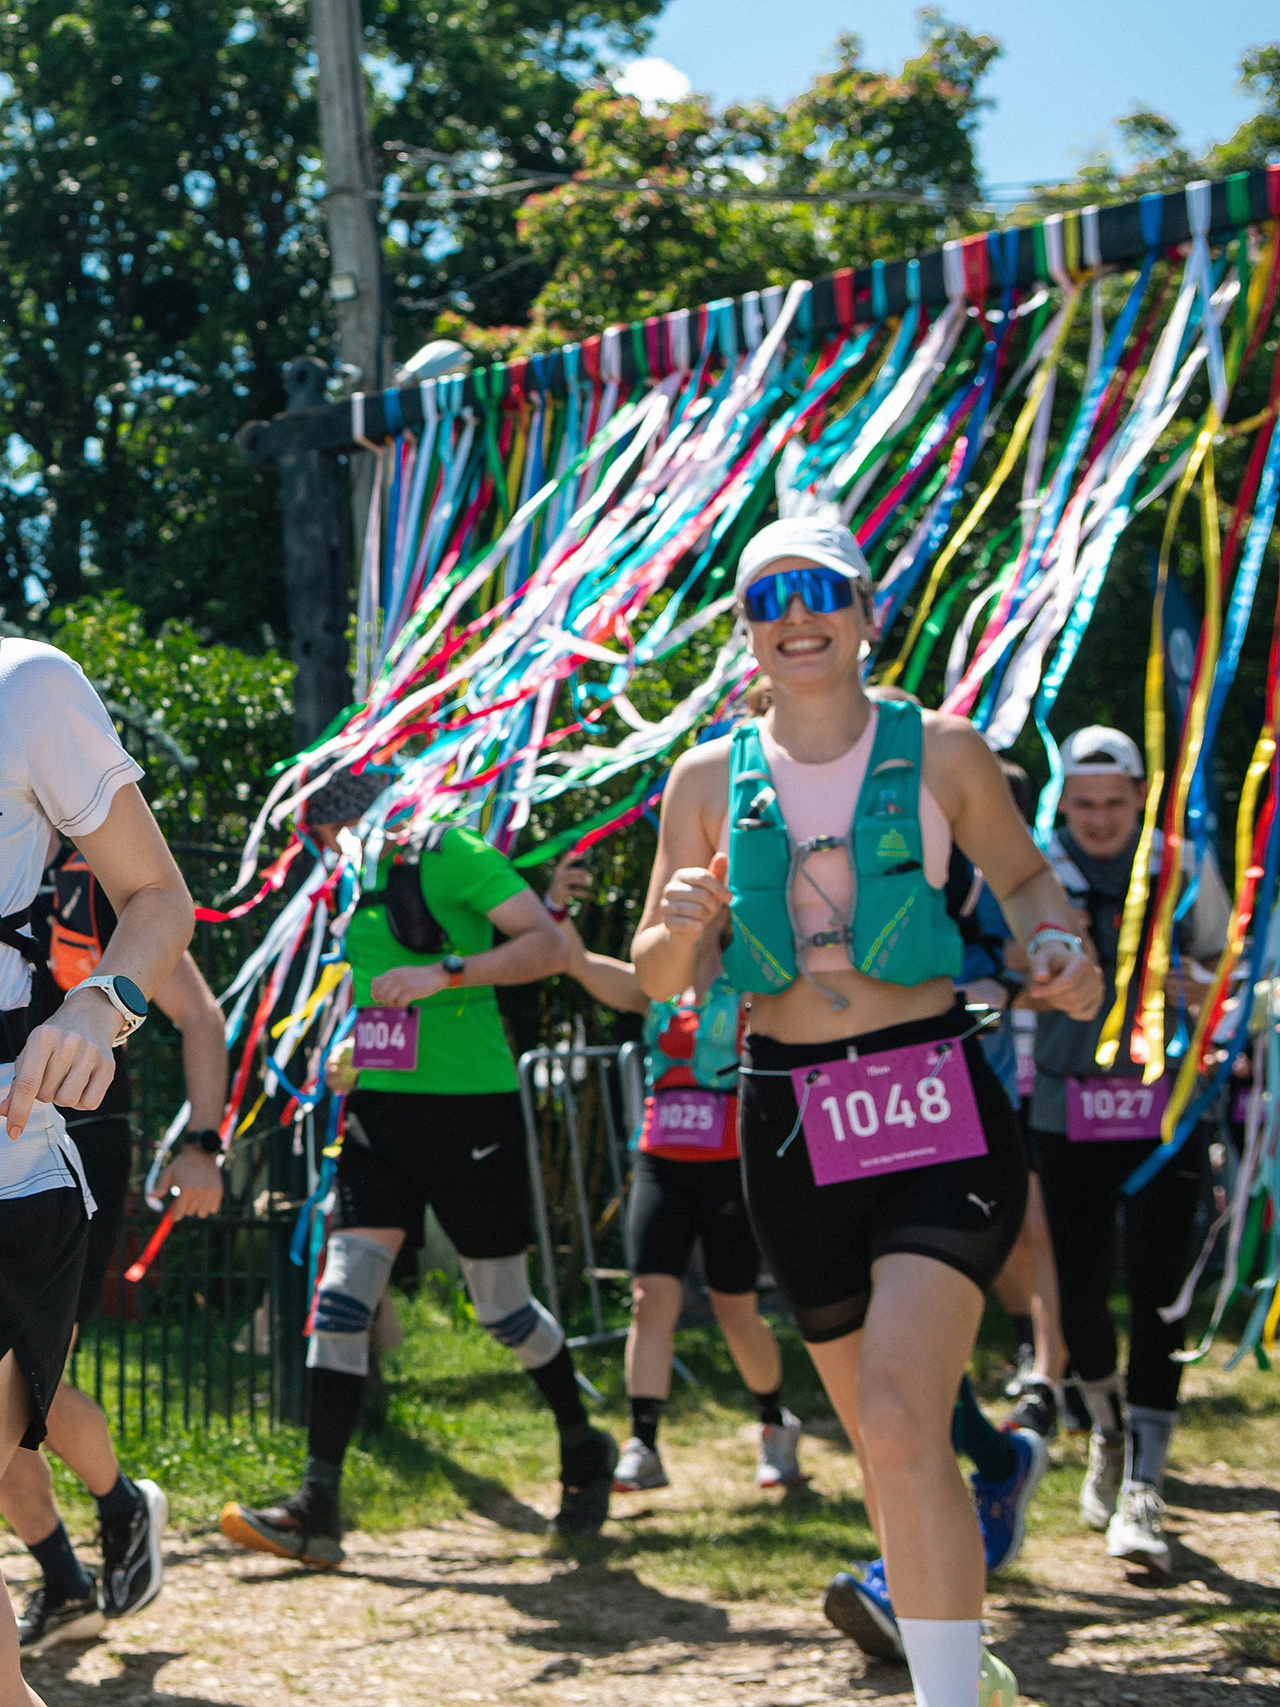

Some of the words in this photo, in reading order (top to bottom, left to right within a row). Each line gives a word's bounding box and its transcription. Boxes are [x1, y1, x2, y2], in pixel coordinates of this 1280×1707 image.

[357, 1021, 406, 1050] 1004
[659, 1103, 714, 1131] 1025
[821, 1076, 951, 1142] 1048
[1080, 1088, 1155, 1120] 1027
